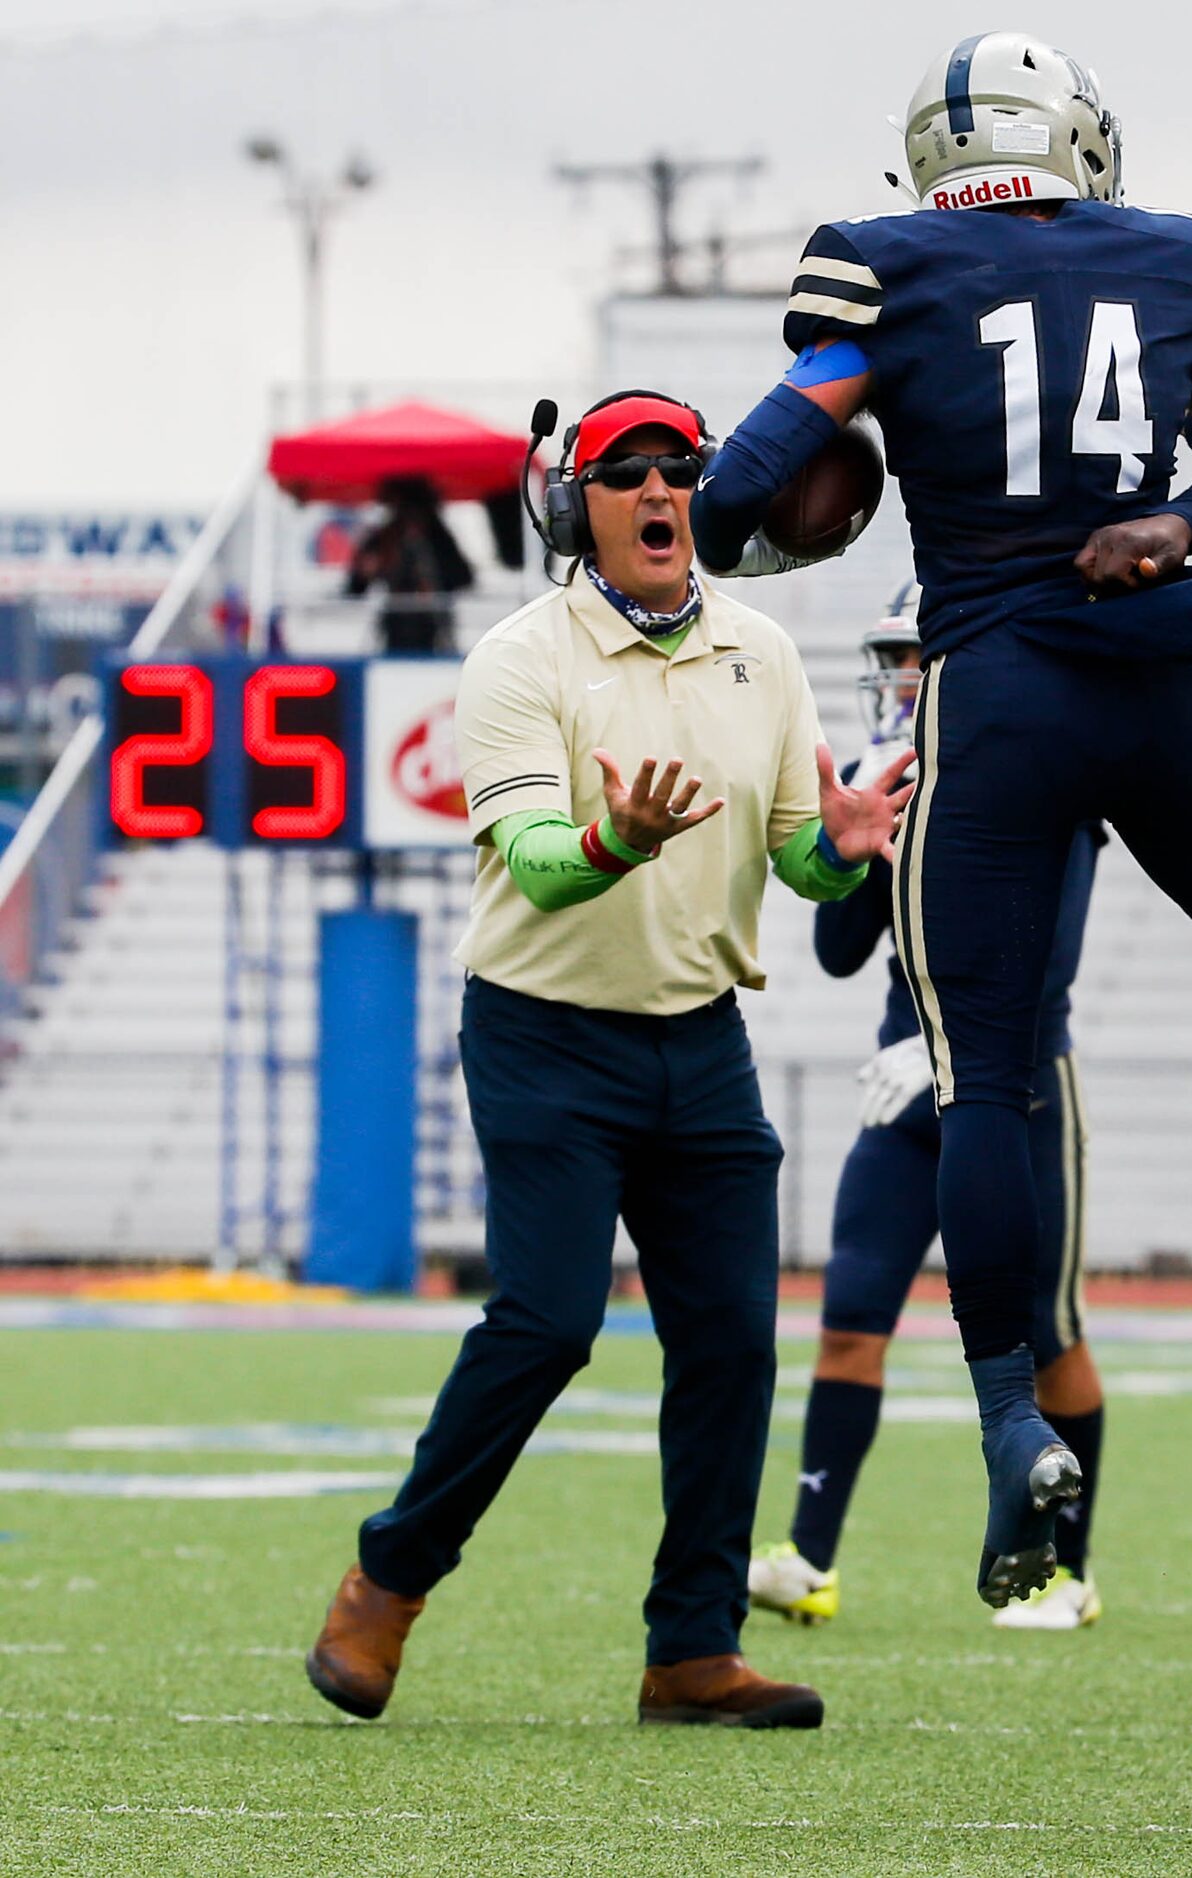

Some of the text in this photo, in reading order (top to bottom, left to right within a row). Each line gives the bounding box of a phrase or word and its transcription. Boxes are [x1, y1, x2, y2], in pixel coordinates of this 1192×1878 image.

[933, 176, 1034, 210] Riddell
[978, 300, 1155, 496] 14
[110, 665, 346, 838] 25
